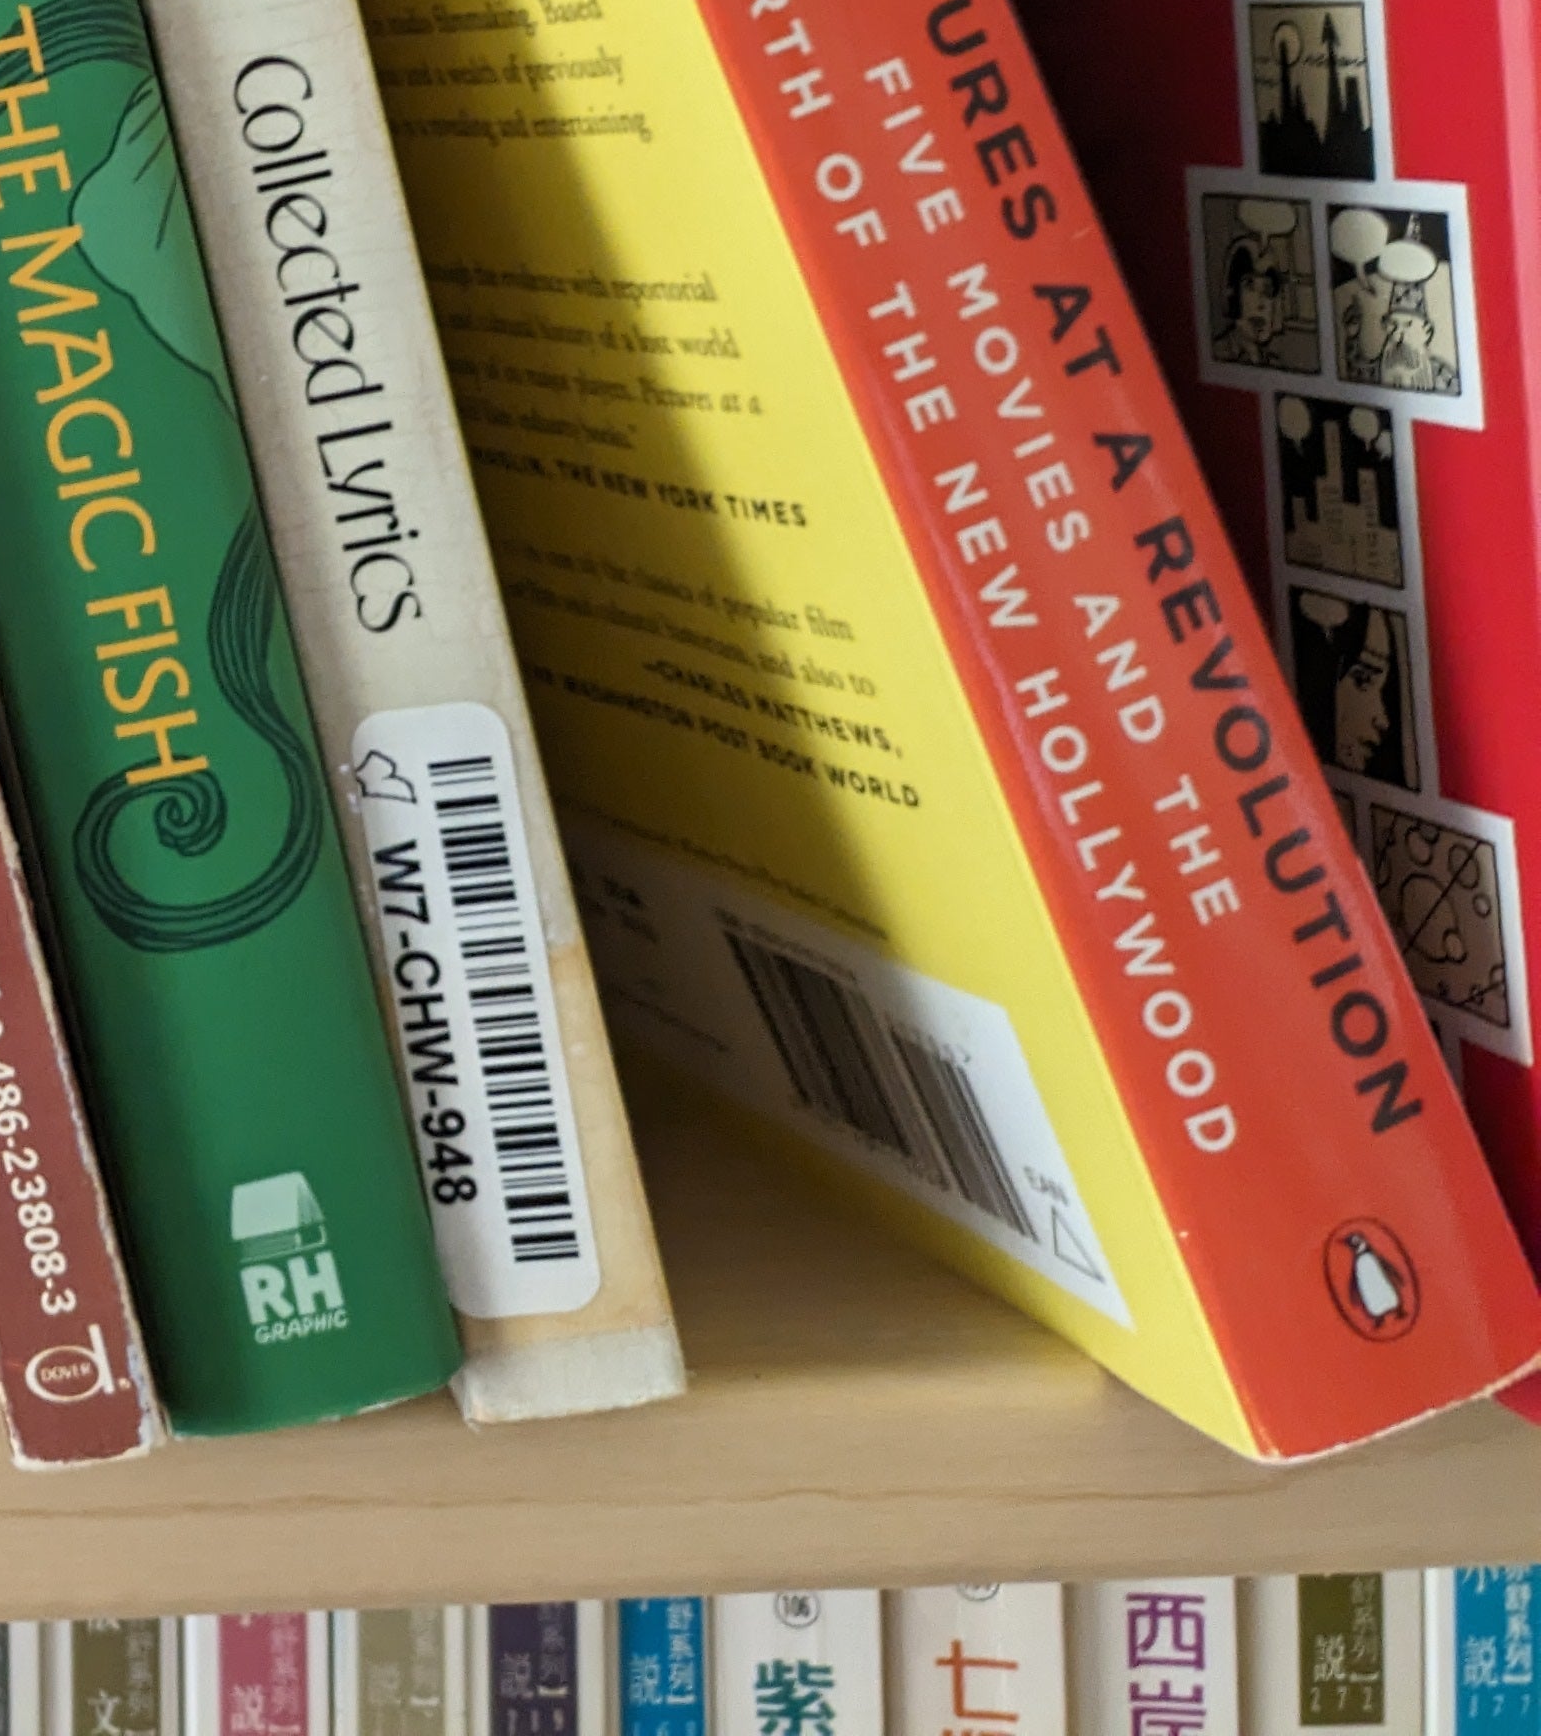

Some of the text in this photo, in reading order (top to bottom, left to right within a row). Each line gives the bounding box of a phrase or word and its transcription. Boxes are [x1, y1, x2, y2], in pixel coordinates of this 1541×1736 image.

[233, 55, 384, 406] Collected
[317, 422, 422, 634] Lyrics
[0, 224, 157, 573] MAGIC
[86, 585, 209, 786] FISH
[655, 482, 718, 514] YORK
[724, 495, 808, 527] TIMES
[865, 57, 1242, 926] FIVE MOVIES AND THE
[816, 152, 889, 247] OF
[867, 281, 958, 434] THE
[934, 462, 1040, 628] NEW
[1016, 667, 1238, 1152] HOLLYWOOD
[1033, 283, 1123, 381] AT
[1093, 431, 1155, 492] A
[1134, 514, 1426, 1135] REVOLUTION
[822, 763, 921, 808] WORLD
[373, 840, 478, 1205] W7-CHW-948
[240, 1250, 345, 1325] RH
[255, 1308, 350, 1345] GRAPHIC
[755, 1658, 834, 1736] 紫
[779, 1593, 810, 1620] 106
